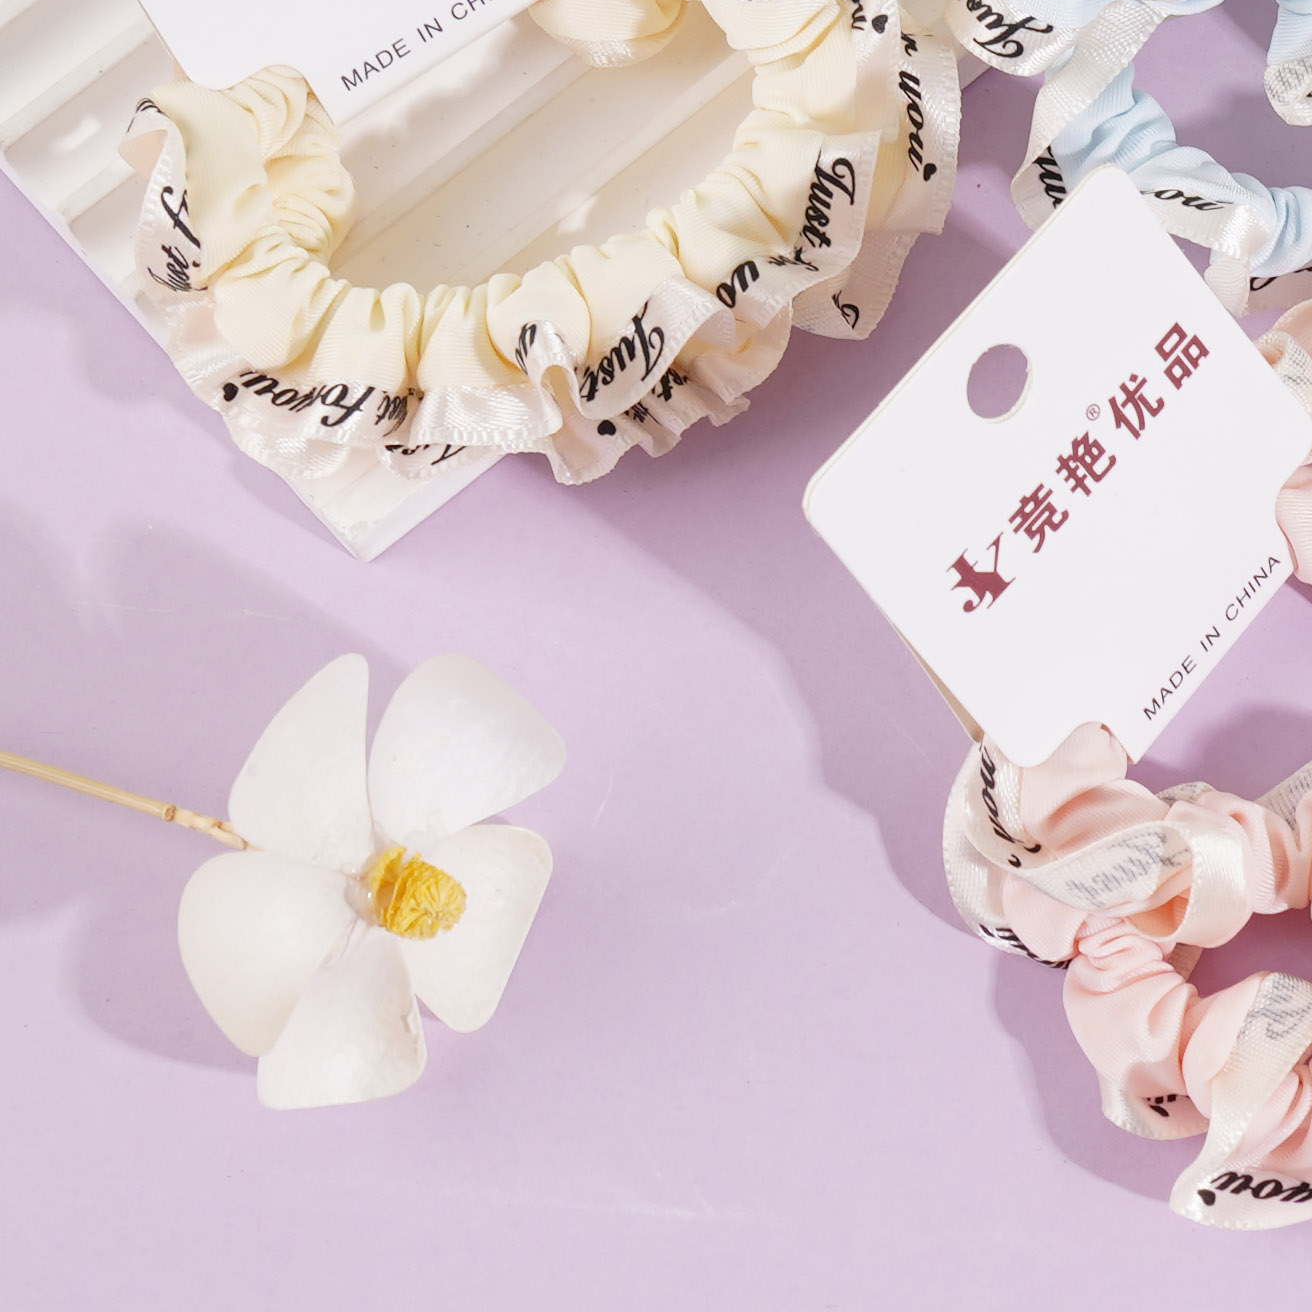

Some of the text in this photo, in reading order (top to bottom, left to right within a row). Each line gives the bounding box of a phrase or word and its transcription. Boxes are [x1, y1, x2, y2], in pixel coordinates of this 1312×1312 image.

[341, 39, 411, 91] MADE
[417, 17, 443, 42] IN
[803, 150, 858, 249] Just
[1141, 188, 1234, 212] ou
[580, 301, 665, 402] Just
[1143, 556, 1281, 720] MADE IN CHINA
